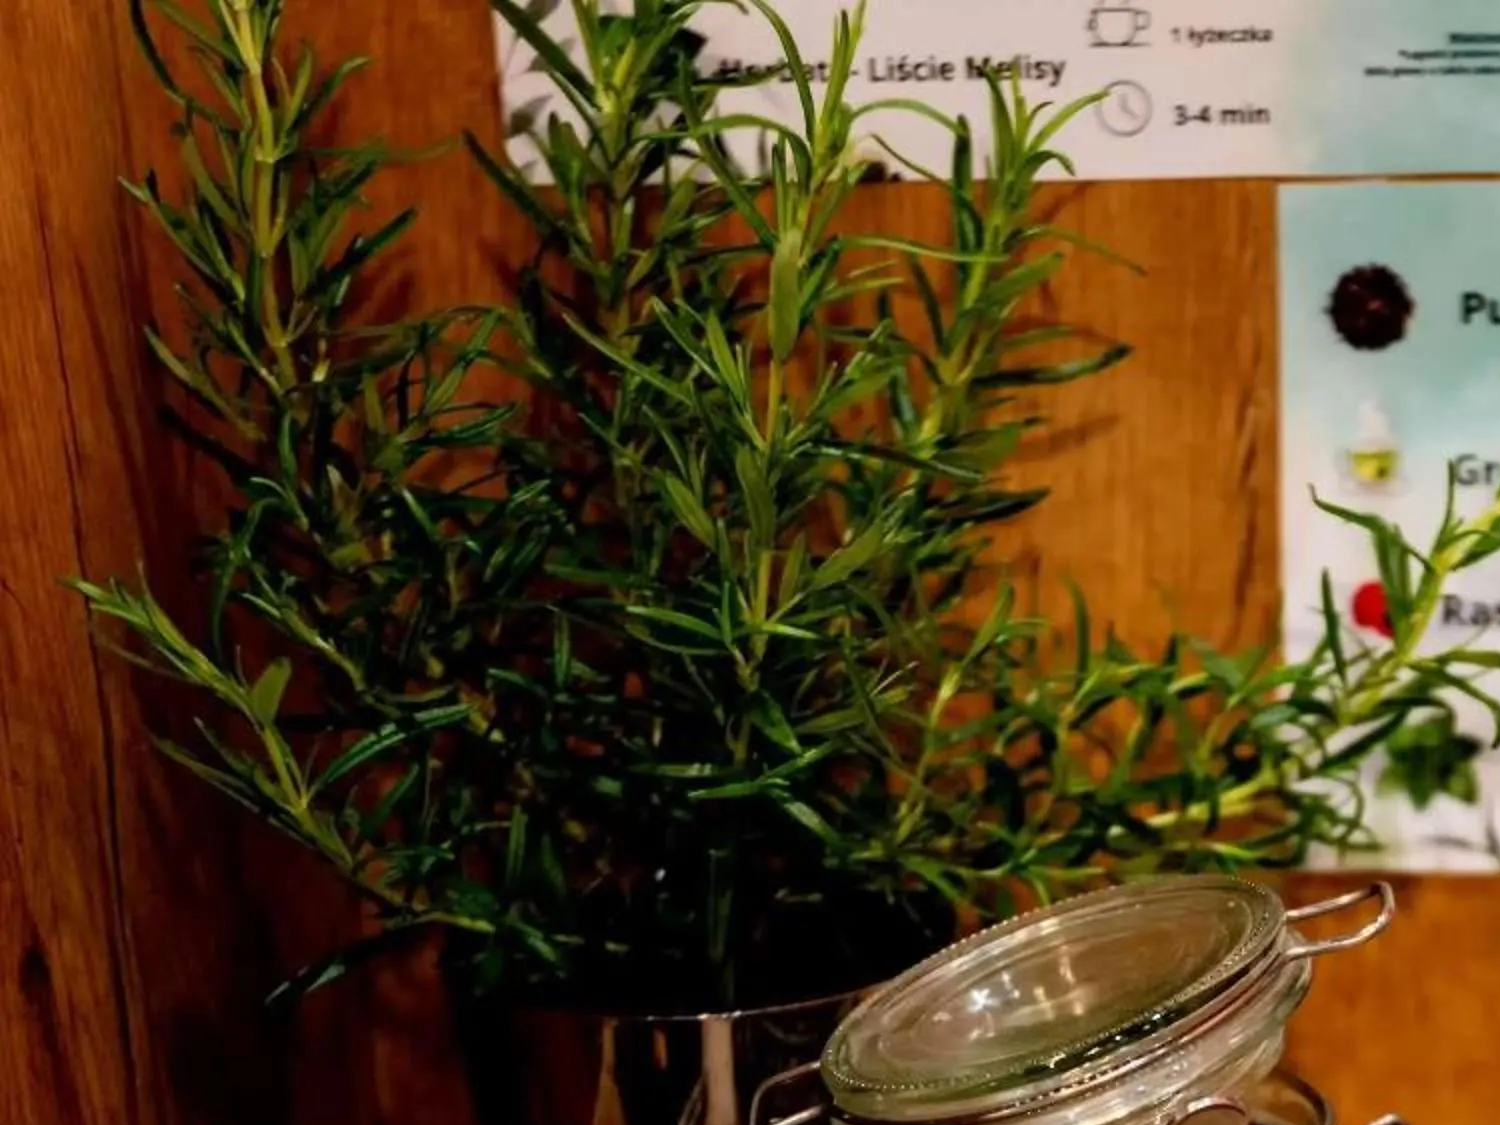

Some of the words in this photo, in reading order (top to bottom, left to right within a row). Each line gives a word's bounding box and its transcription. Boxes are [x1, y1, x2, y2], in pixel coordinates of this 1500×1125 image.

[868, 55, 955, 82] Liście
[1174, 104, 1212, 126] 3-4
[1220, 103, 1271, 126] min
